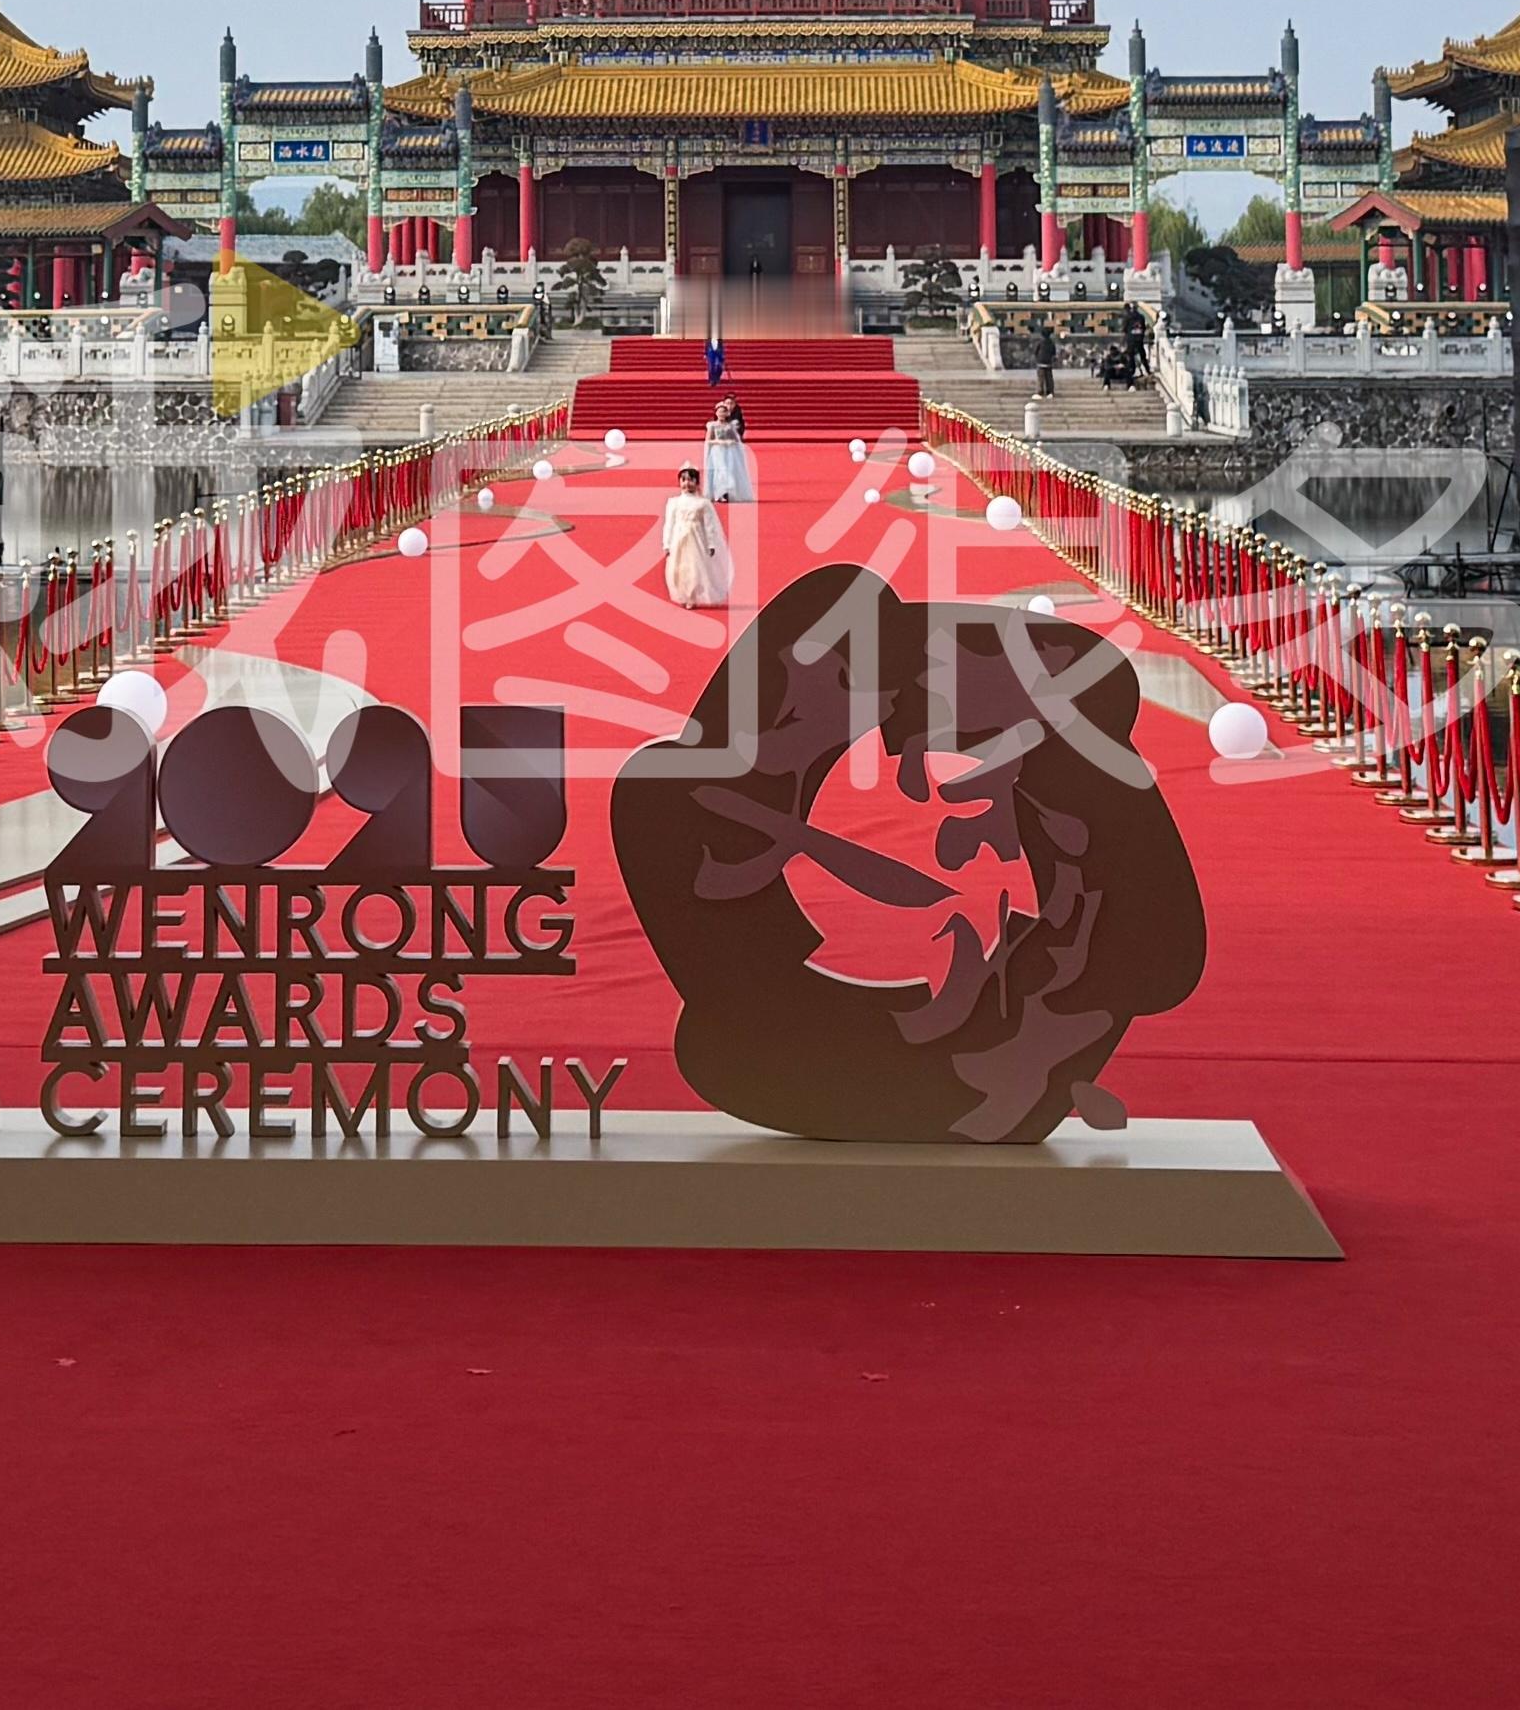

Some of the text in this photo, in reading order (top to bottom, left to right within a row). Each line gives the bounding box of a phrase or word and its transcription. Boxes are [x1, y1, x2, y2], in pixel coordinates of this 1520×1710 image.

[46, 880, 575, 962] WENRONG
[43, 972, 469, 1050] AWARDS
[39, 1057, 628, 1140] CEREMONY
